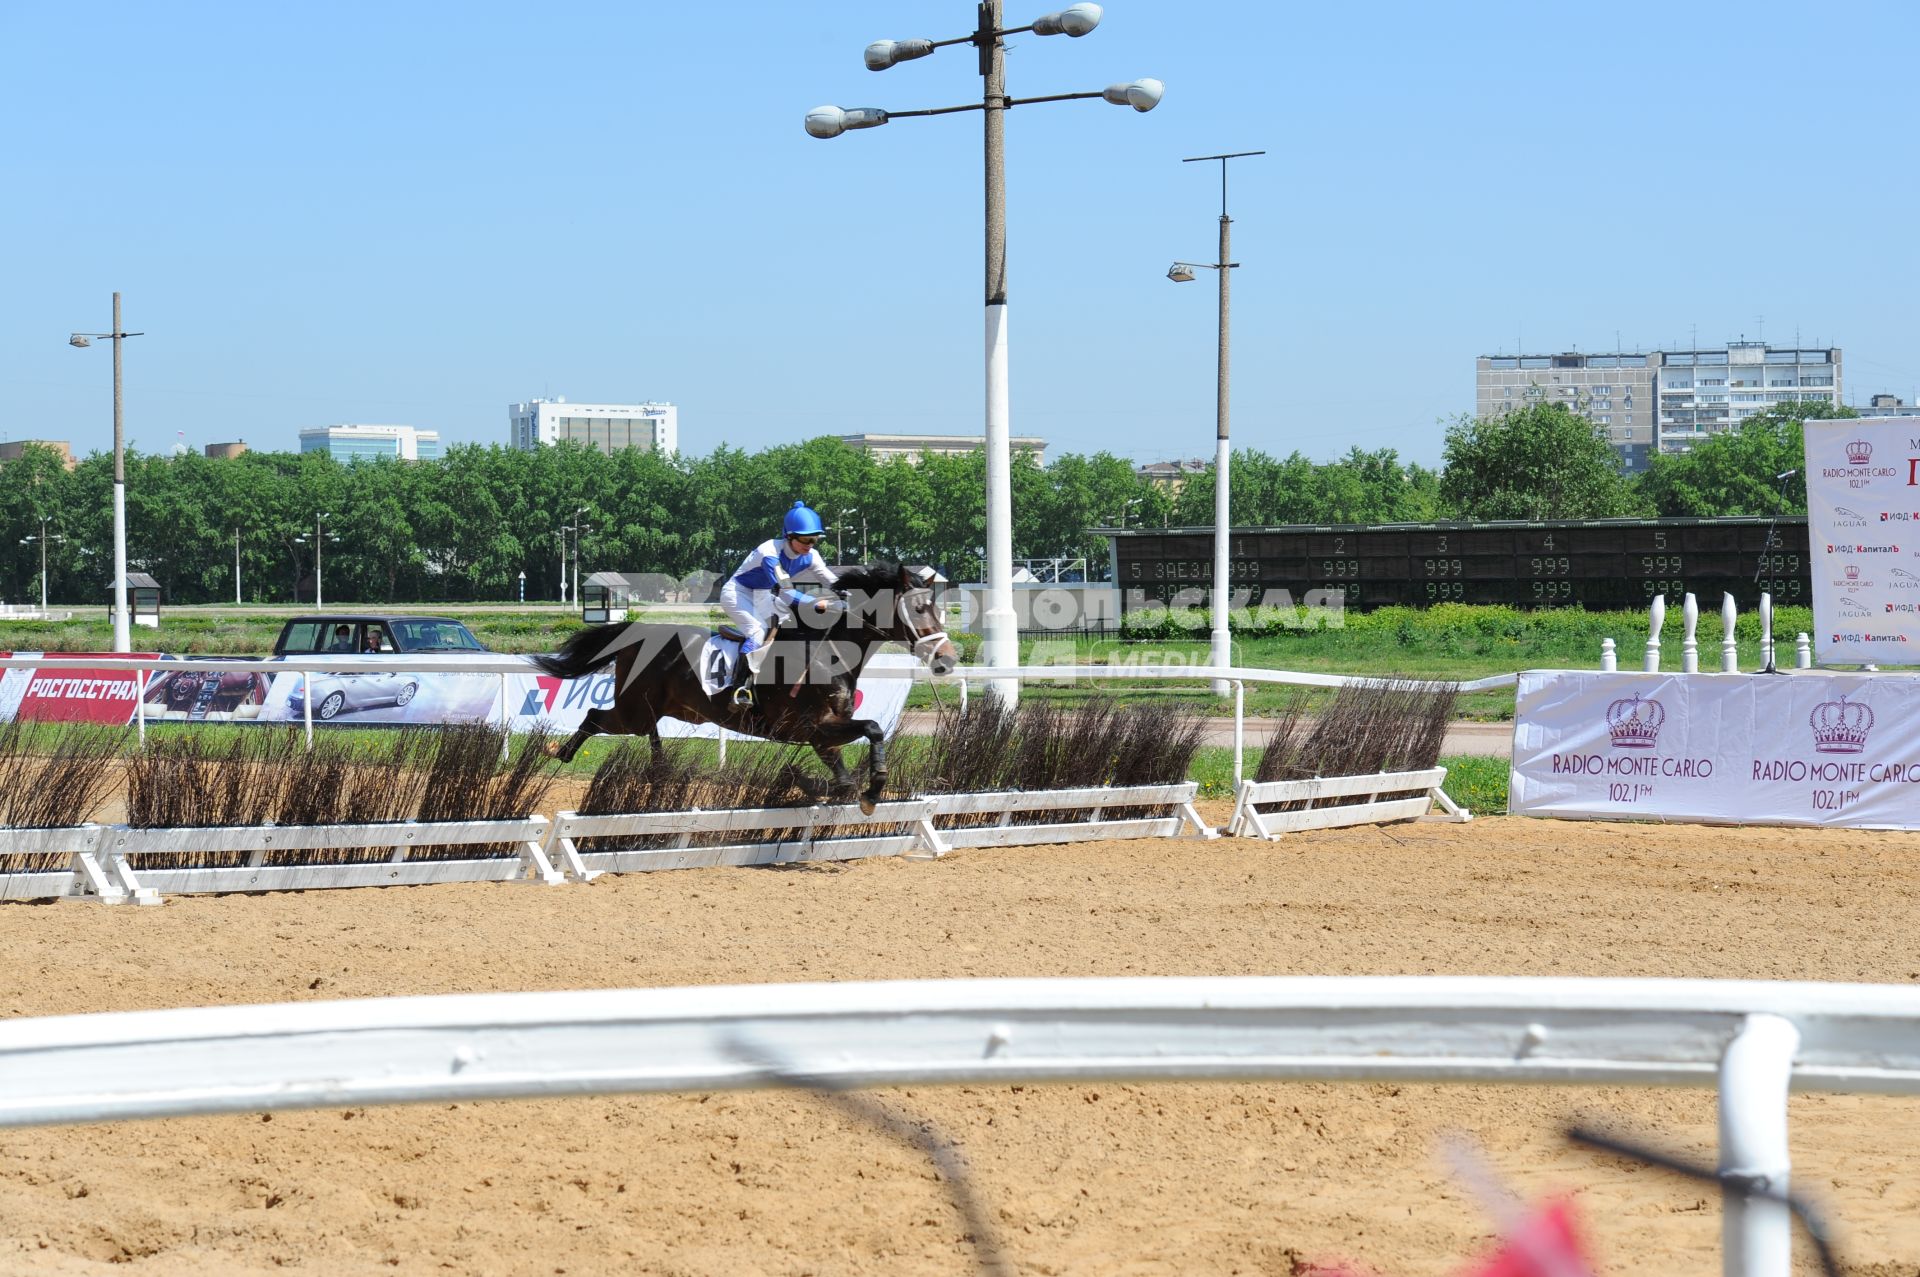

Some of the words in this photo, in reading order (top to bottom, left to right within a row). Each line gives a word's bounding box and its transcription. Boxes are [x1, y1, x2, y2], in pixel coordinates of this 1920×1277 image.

[1823, 468, 1846, 478] RADIO
[1847, 468, 1871, 478] MONTE
[1872, 467, 1897, 477] CARLO
[1235, 540, 1246, 557] 1
[1334, 537, 1345, 554] 2
[1437, 536, 1448, 552] 3
[1543, 533, 1555, 551] 4
[1655, 532, 1666, 549] 5
[1131, 562, 1142, 578] 5
[1323, 560, 1359, 577] 999
[1425, 559, 1462, 576] 999
[1531, 557, 1570, 575] 999
[1642, 556, 1682, 574] 999
[1426, 582, 1463, 599] 999
[1532, 581, 1571, 598] 999
[1889, 582, 1920, 590] JAGUA
[710, 649, 727, 688] 4
[27, 678, 138, 700] РОСГОССТРАХ
[1553, 754, 1604, 775] RADIO
[1607, 757, 1658, 776] MONTE
[1662, 758, 1713, 778] CARLO
[1753, 760, 1806, 781] RADIO
[1810, 763, 1866, 782] MONTE
[1870, 764, 1920, 783] CARLO
